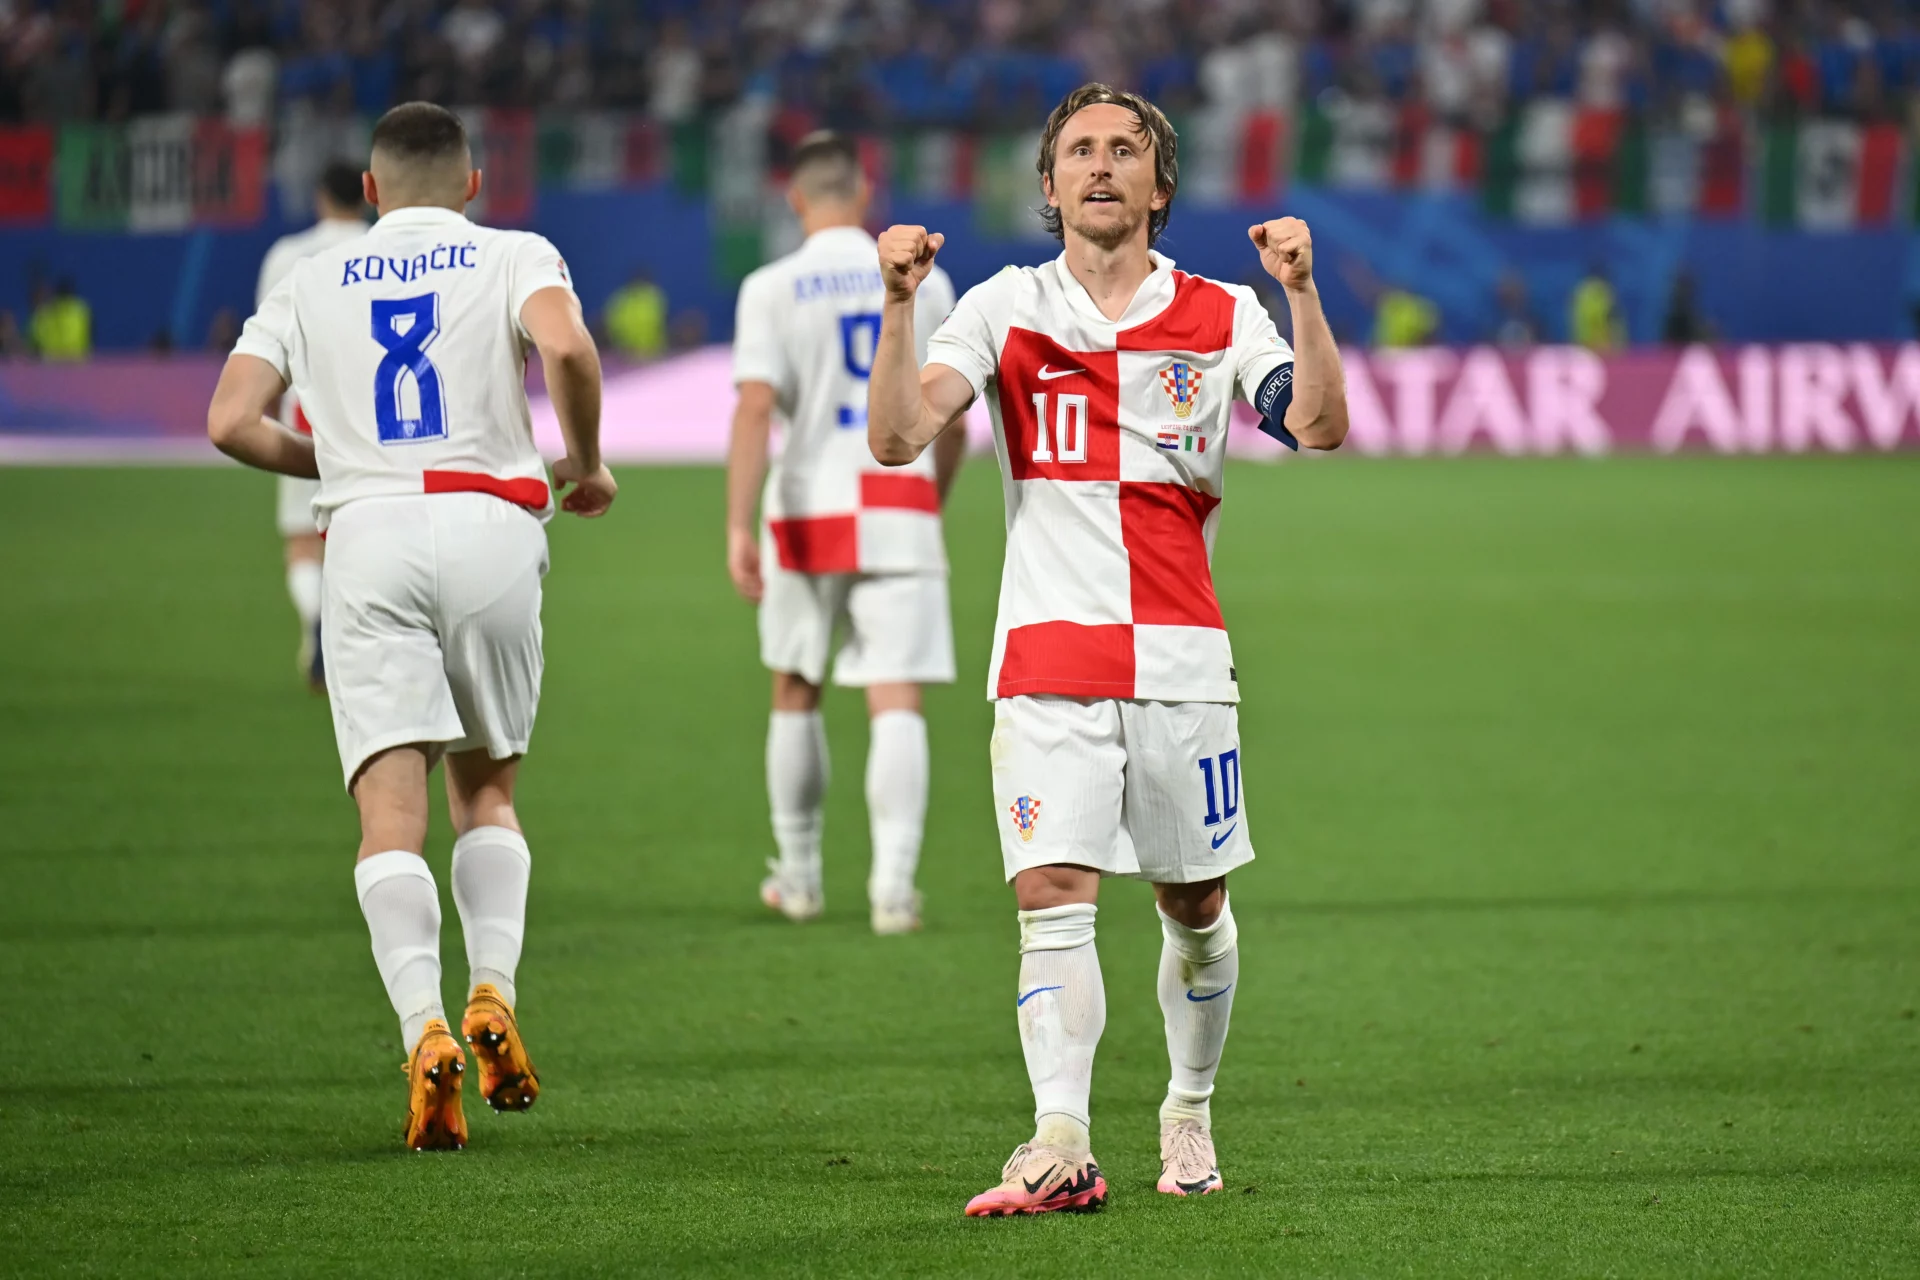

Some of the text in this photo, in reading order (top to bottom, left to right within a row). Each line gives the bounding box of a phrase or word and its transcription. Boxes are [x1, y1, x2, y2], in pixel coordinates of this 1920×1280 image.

[371, 291, 448, 446] 8
[1177, 367, 1186, 397] HNS
[1262, 369, 1293, 411] RESPECT
[1032, 393, 1088, 463] 10
[1199, 748, 1238, 827] 10
